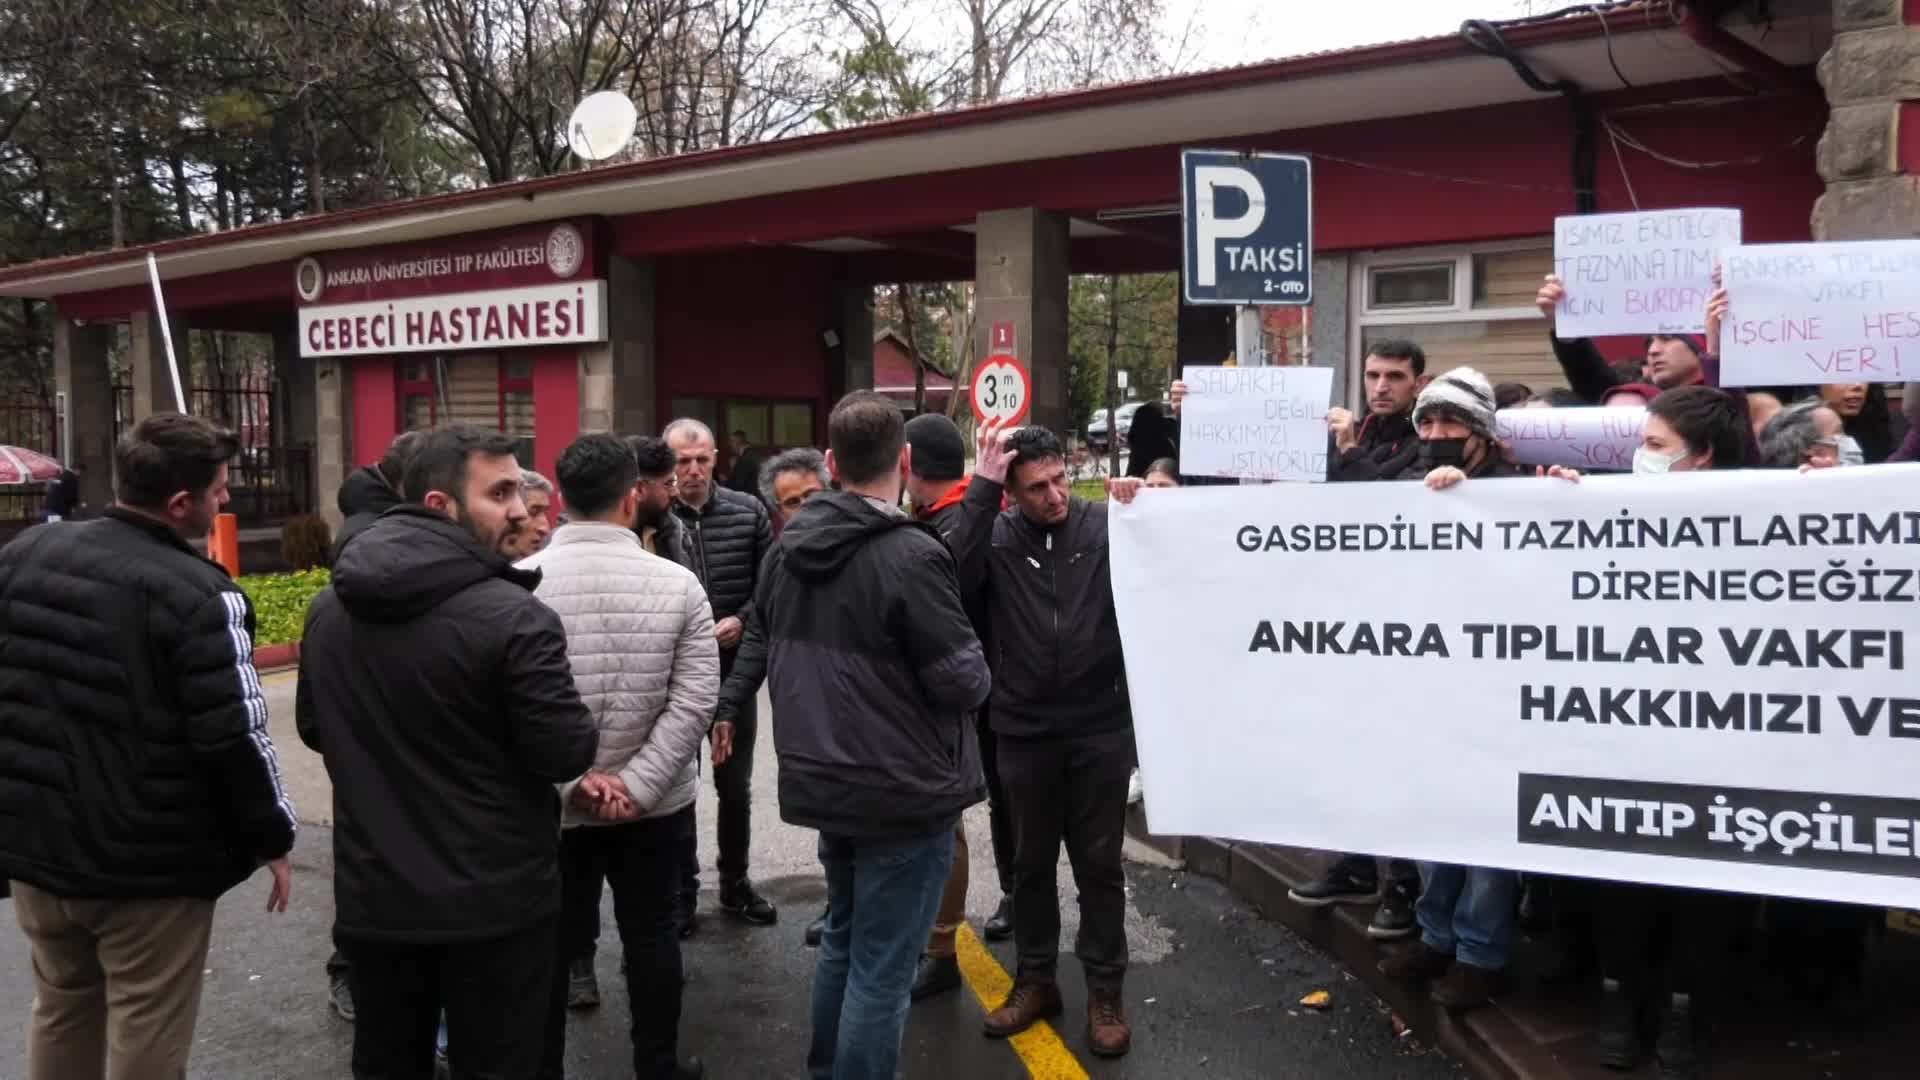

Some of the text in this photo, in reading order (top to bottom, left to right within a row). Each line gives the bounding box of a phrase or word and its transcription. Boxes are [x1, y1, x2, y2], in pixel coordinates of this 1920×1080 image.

[1195, 166, 1266, 286] P
[326, 242, 545, 287] ANKARA ÜNİVERSİTESİ TIP FAKÜLTESİ
[1224, 242, 1303, 273] TAKSİ
[308, 287, 584, 351] CEBECİ HASTANESİ
[1000, 328, 1005, 343] 1
[1235, 513, 1484, 553] GASBEDİLEN
[1248, 619, 1904, 671] ANKARA TIPLILAR VAKFI
[1519, 685, 1920, 740] HAKKIMIZI VE
[1530, 791, 1696, 838] ANTIP
